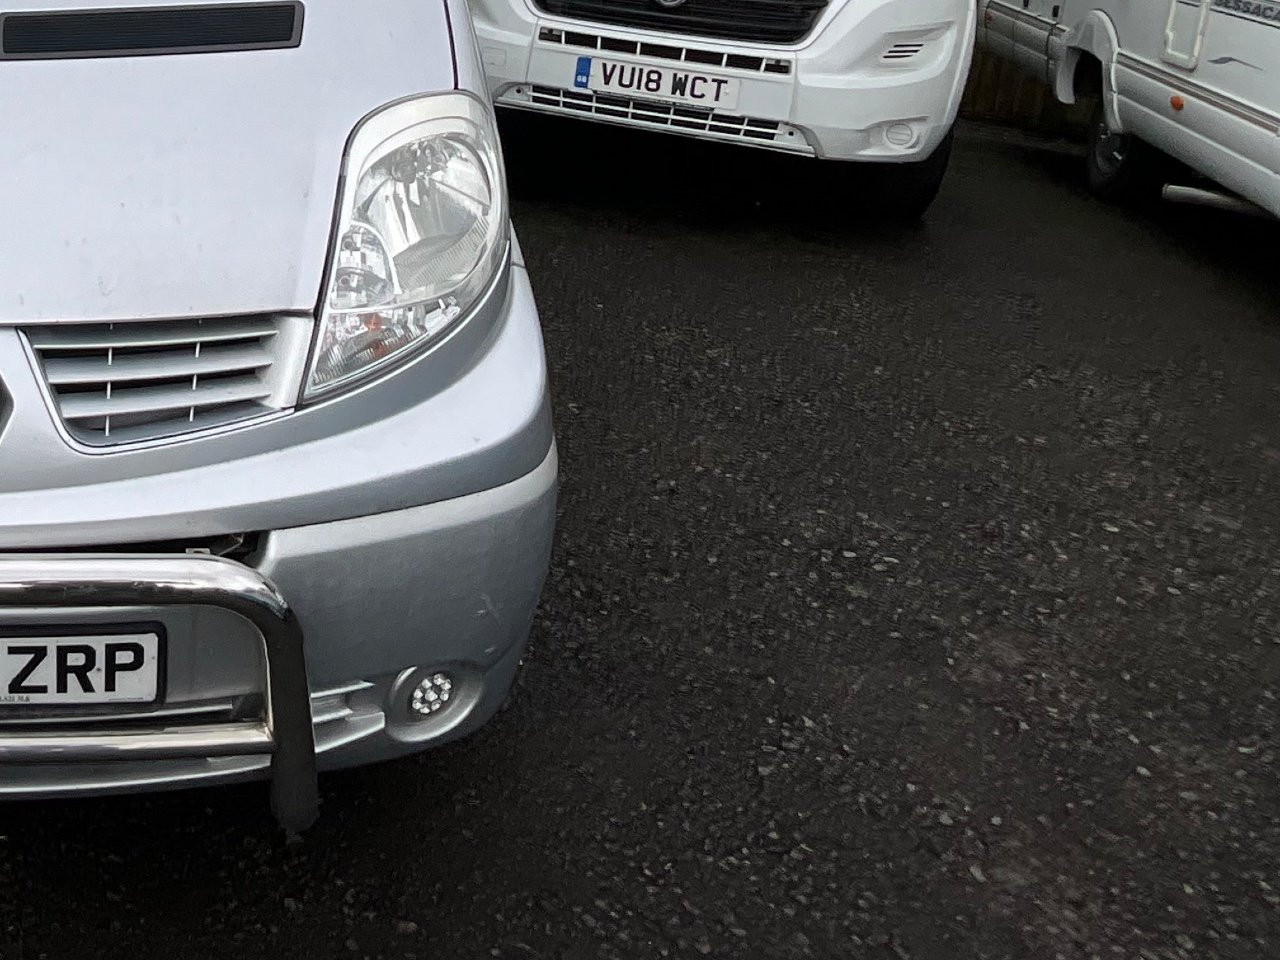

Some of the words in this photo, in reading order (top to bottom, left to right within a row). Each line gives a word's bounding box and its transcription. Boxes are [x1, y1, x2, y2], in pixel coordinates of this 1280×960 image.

[602, 62, 662, 92] VU18
[671, 72, 728, 102] WCT
[7, 642, 145, 694] ZRP
